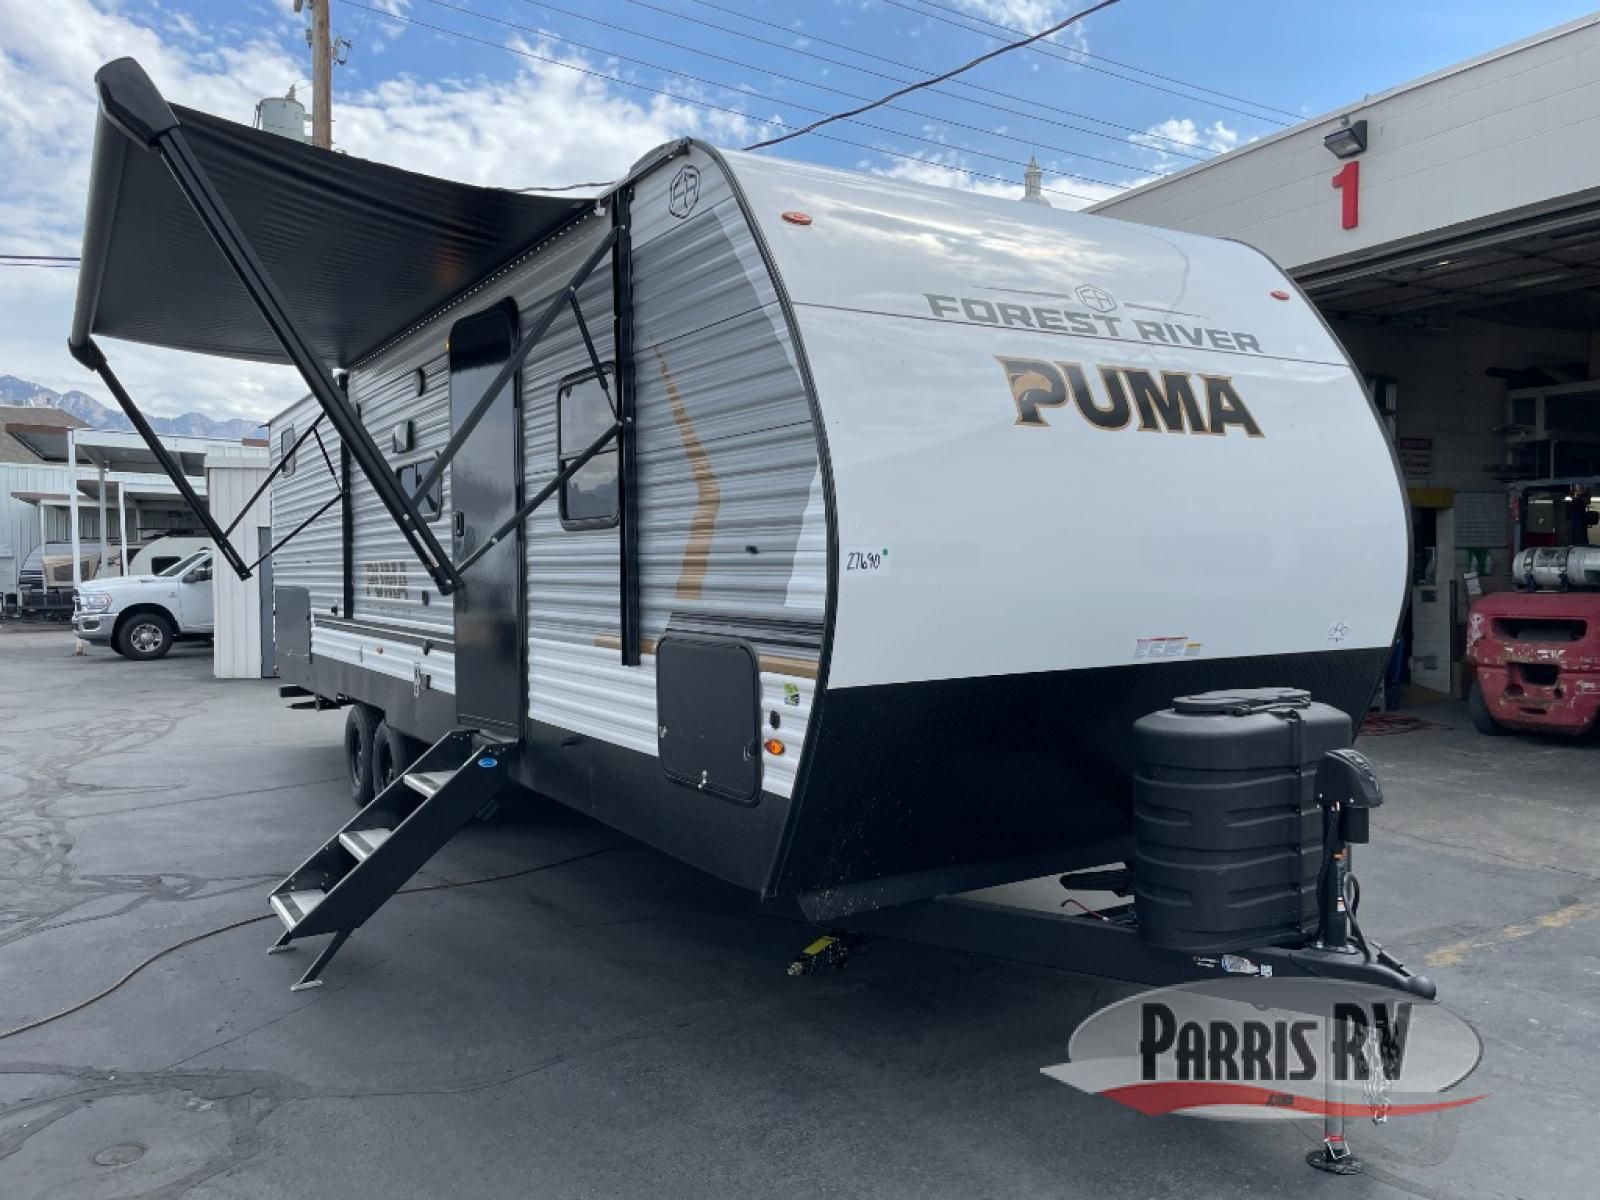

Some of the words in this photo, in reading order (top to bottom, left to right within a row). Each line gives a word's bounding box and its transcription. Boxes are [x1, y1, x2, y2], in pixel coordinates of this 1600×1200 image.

[1331, 160, 1359, 231] 1
[922, 293, 1122, 337] FOREST
[1132, 318, 1264, 353] RIVER
[994, 355, 1265, 438] PUMA
[366, 562, 409, 600] PUMA
[846, 551, 881, 571] 27690
